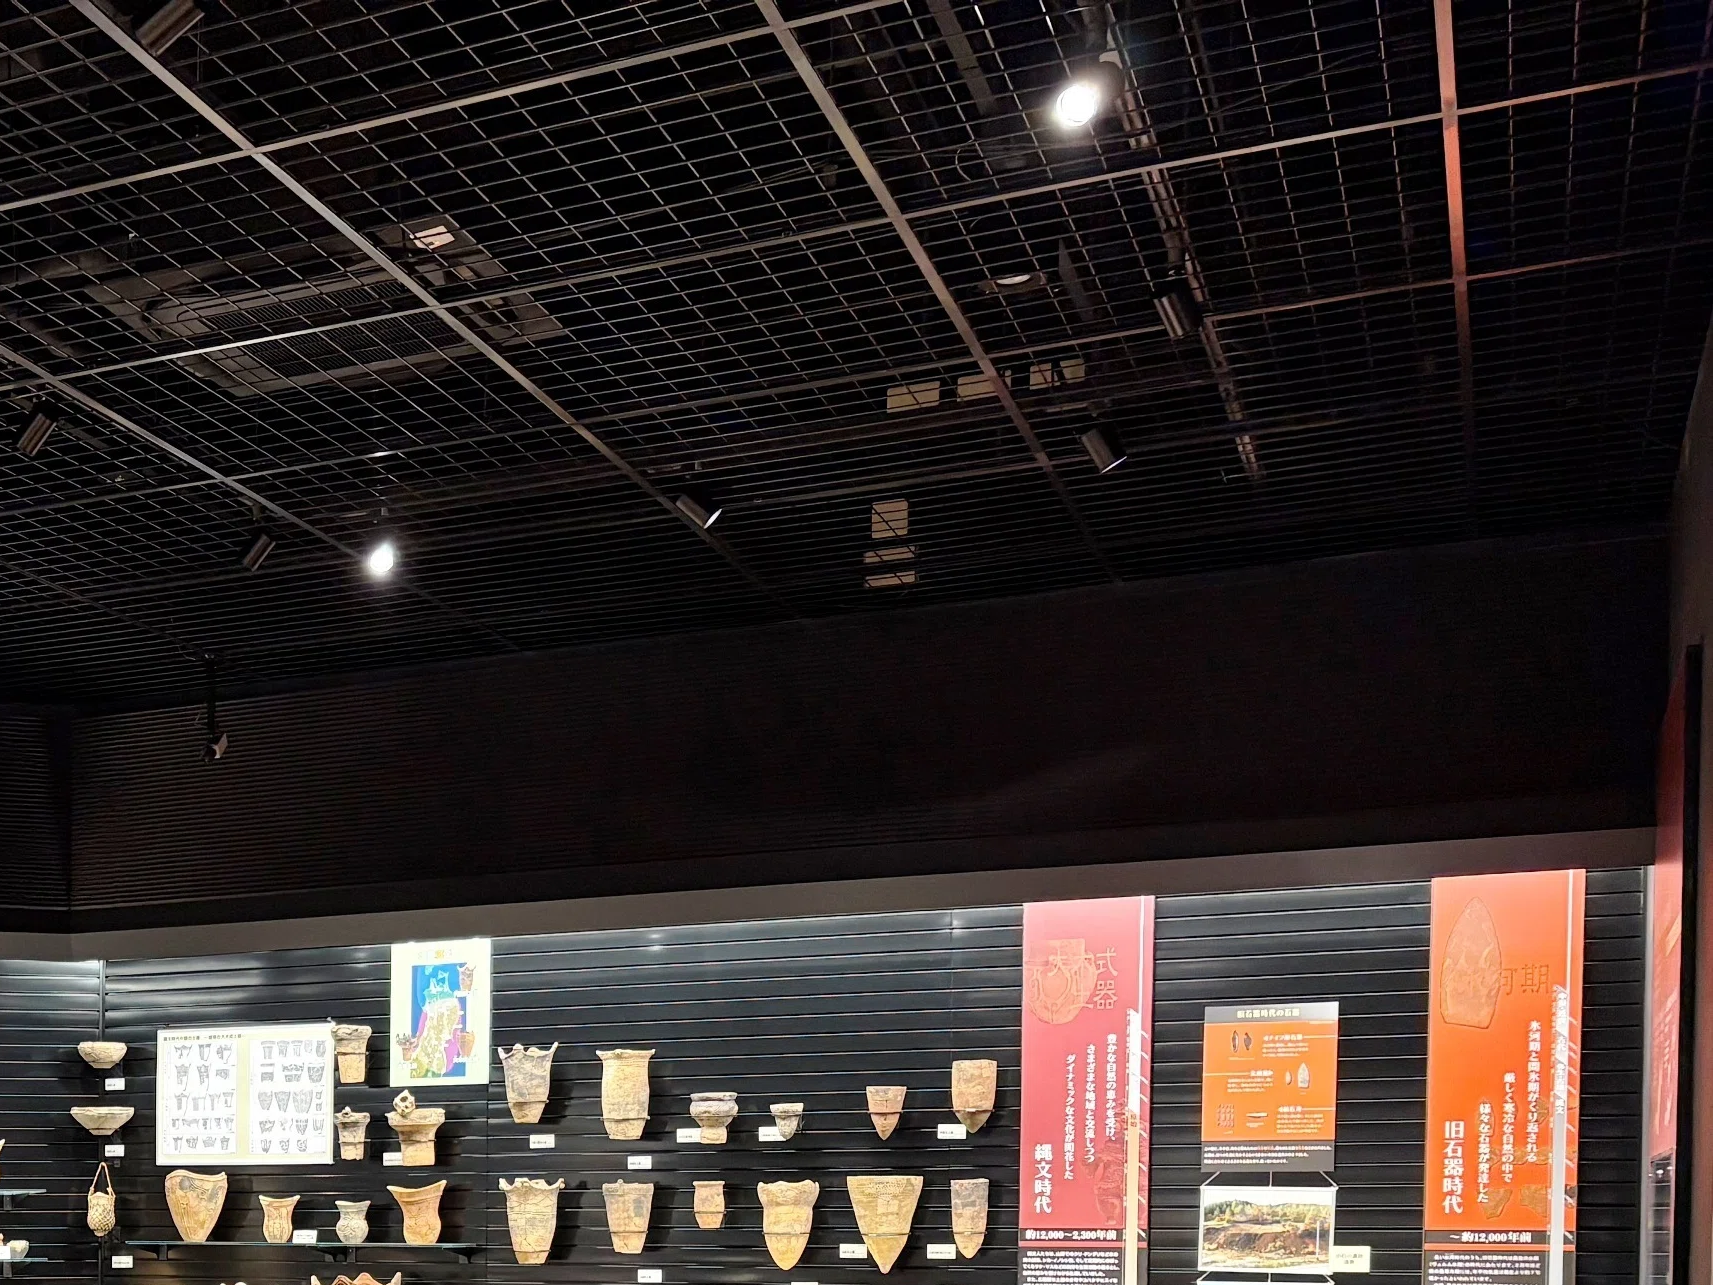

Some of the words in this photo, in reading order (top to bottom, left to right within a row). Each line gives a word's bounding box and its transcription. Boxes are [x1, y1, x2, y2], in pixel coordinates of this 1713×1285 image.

[1034, 1143, 1053, 1214] 縄文時代
[1442, 1121, 1465, 1214] 旧石器時代
